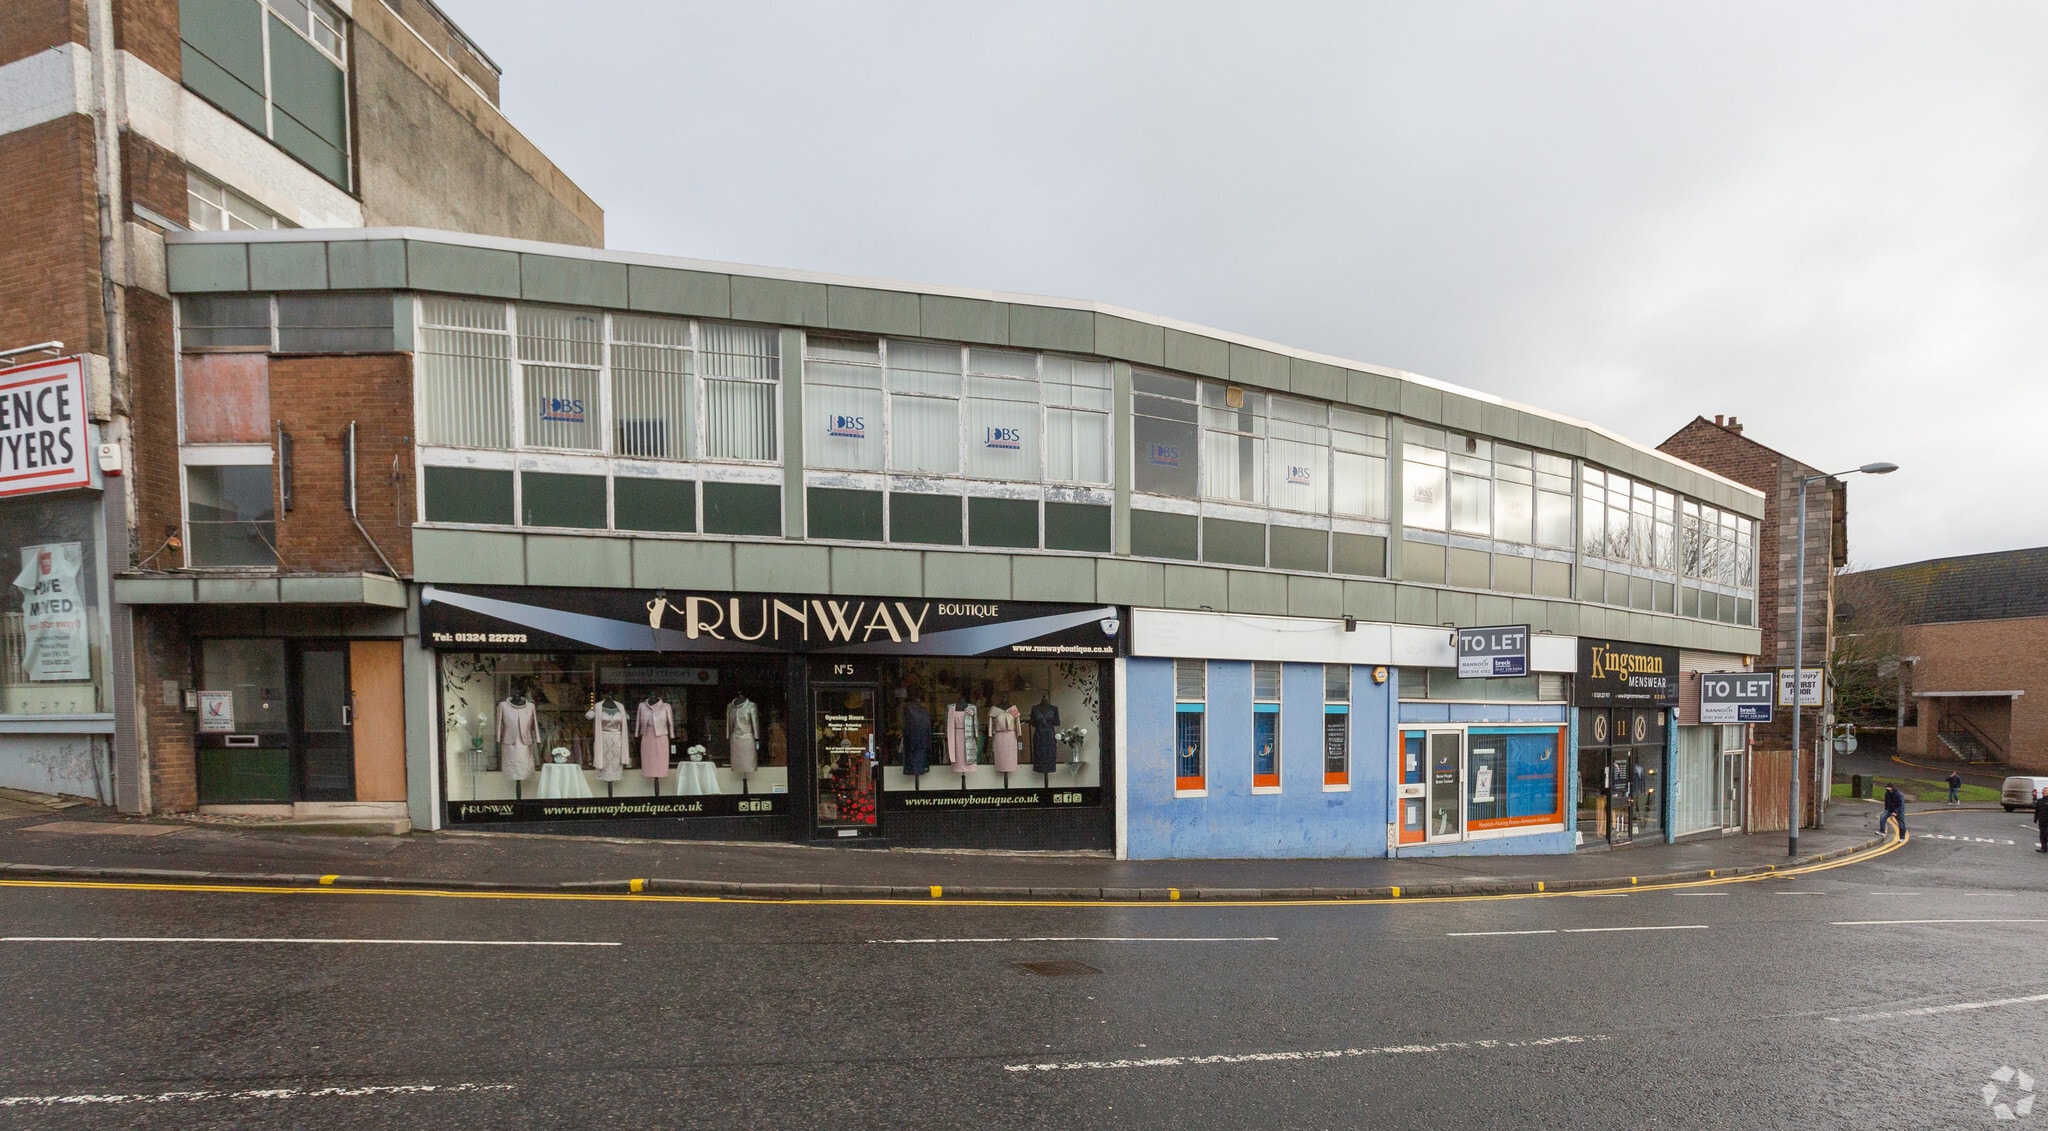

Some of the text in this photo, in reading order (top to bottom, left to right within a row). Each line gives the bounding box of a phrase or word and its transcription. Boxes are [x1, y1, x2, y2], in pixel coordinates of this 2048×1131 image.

[0, 384, 71, 431] ENCE
[0, 427, 73, 473] YERS
[686, 596, 999, 644] RUNWAY BOUTIQUE
[433, 632, 528, 643] Tel: 01324 227373
[1461, 633, 1524, 651] TO LET
[1012, 644, 1114, 654] www.runwayboutique.co.uk
[1591, 643, 1663, 681] Kingsman
[1628, 676, 1666, 688] MENSWEAR
[1704, 680, 1770, 697] TO LET
[543, 801, 703, 817] www.runwayboutique.co.uk
[905, 794, 1039, 808] www.runwayboutique.co.uk
[469, 805, 514, 815] RUNWAY
